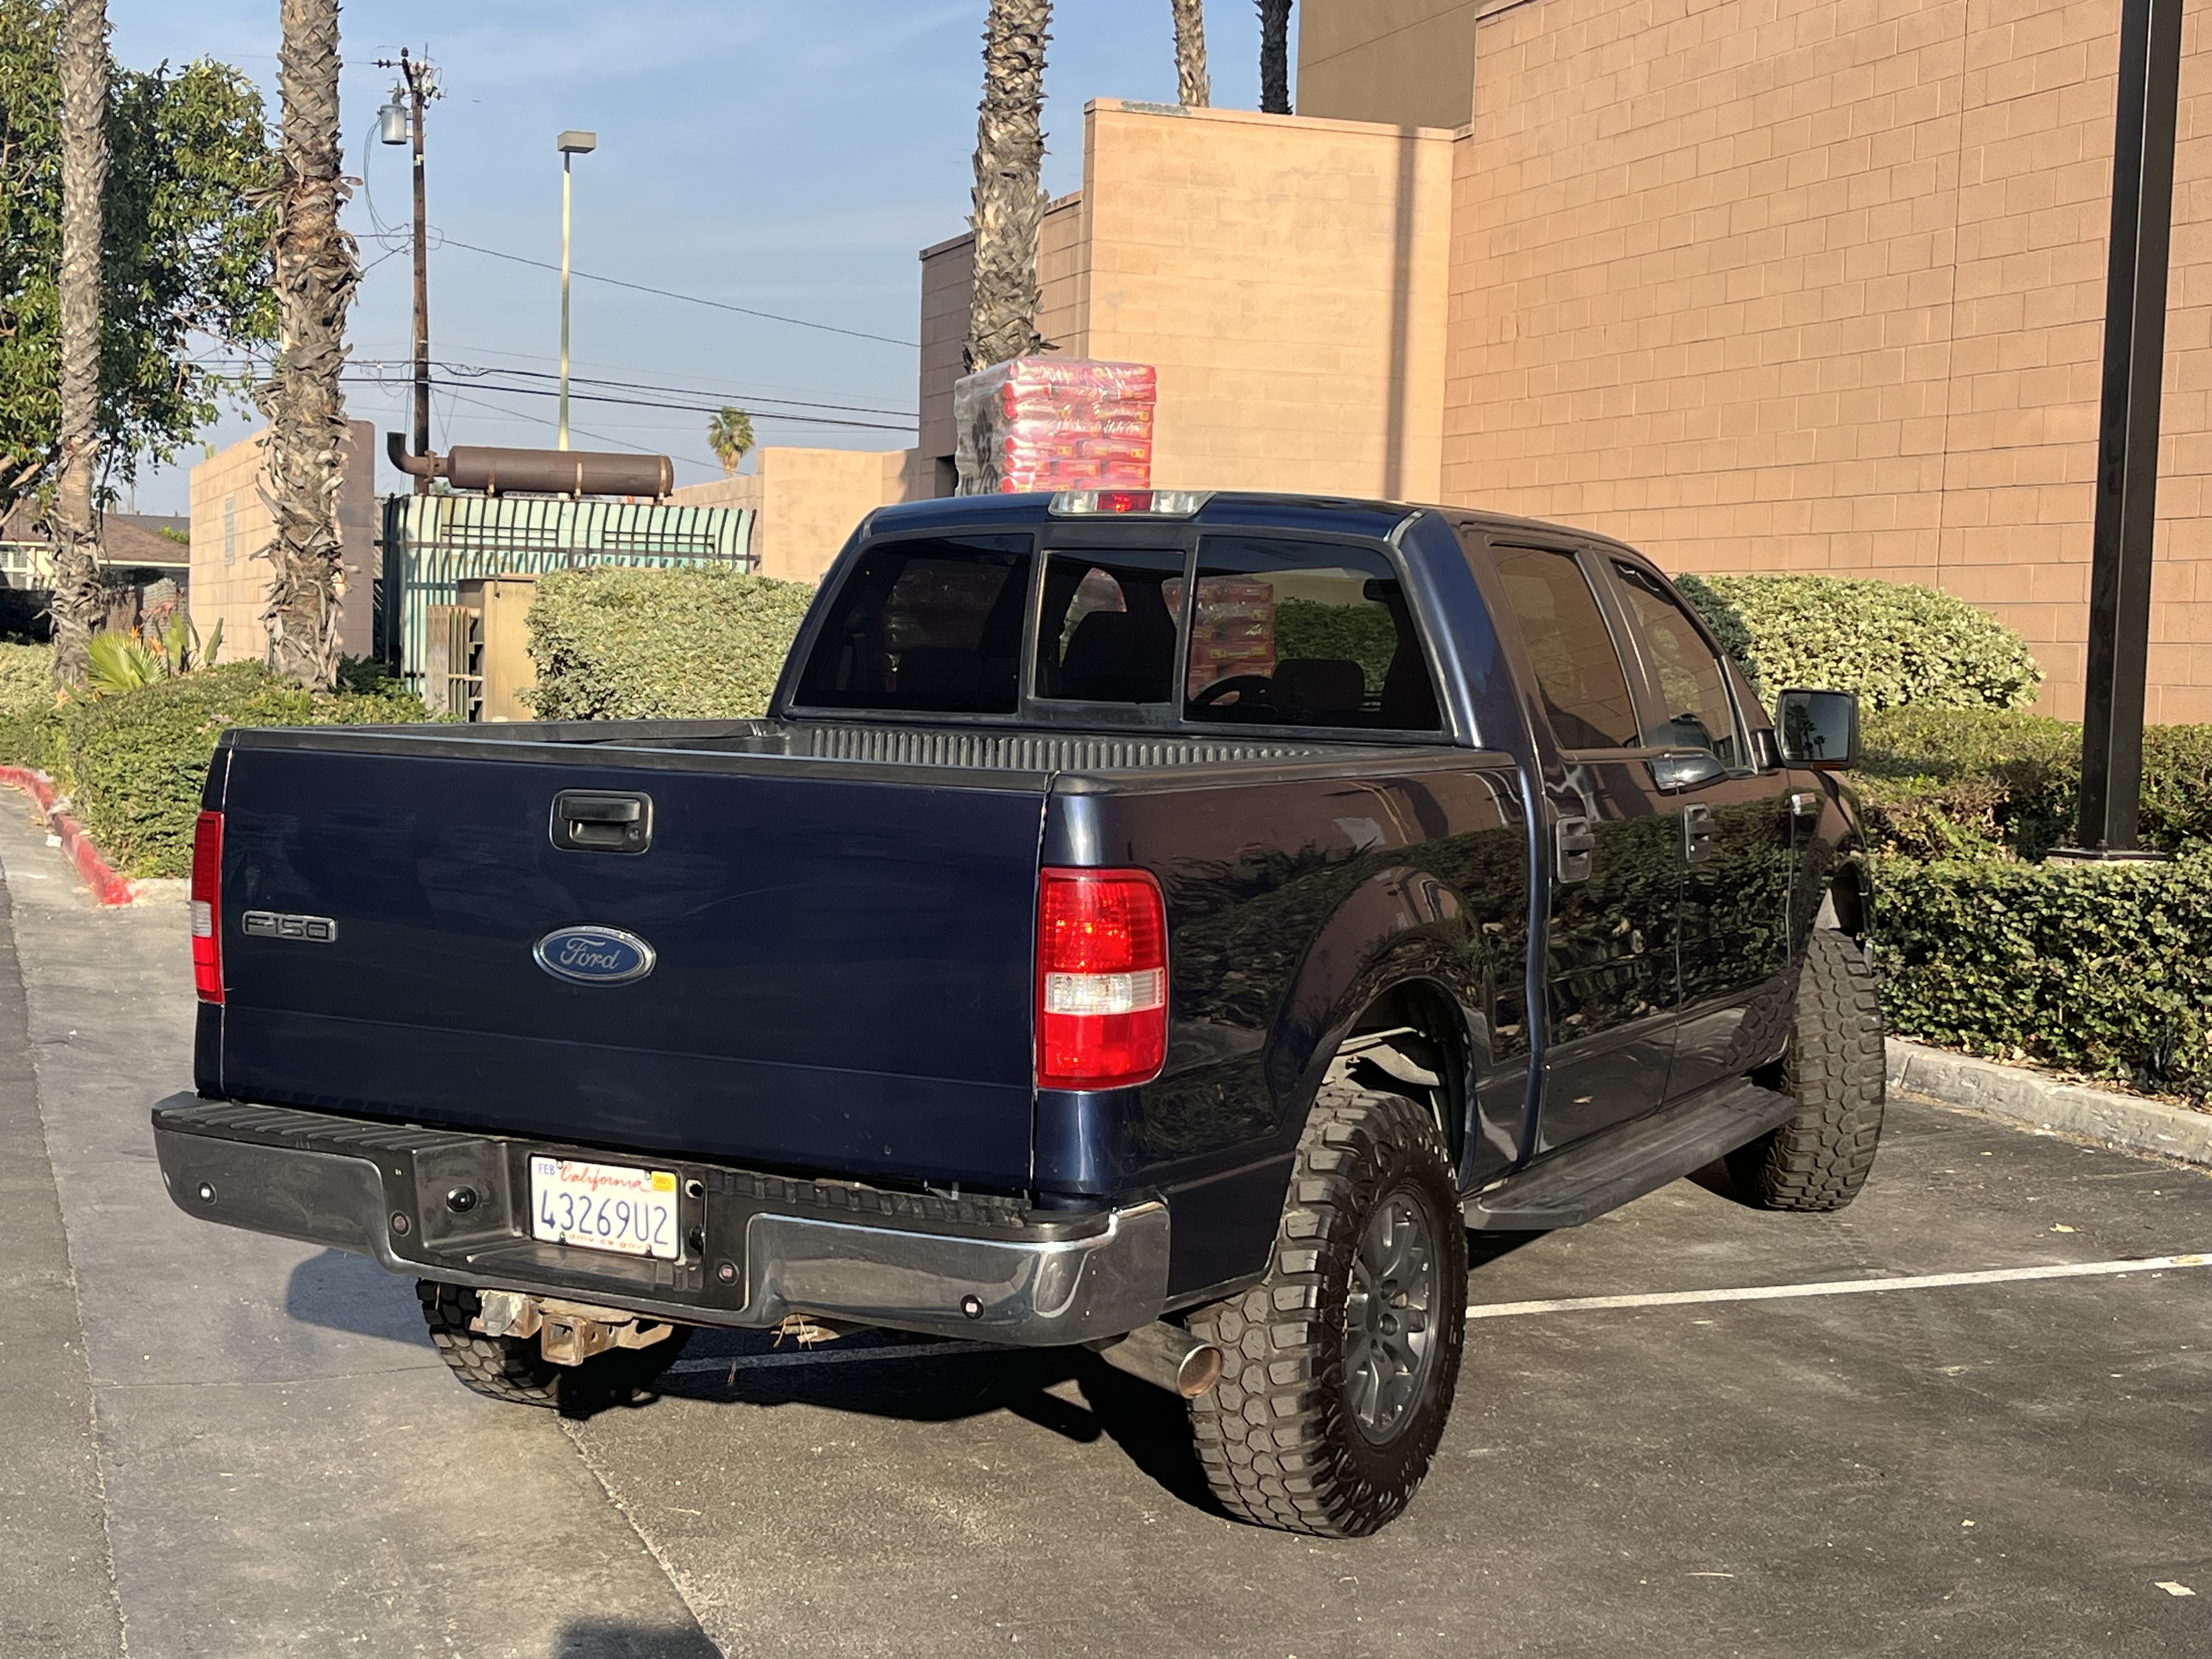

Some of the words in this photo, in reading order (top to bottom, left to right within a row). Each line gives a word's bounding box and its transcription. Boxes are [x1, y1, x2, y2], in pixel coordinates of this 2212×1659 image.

[560, 938, 621, 969] Ford
[538, 1163, 555, 1175] FEB
[560, 1162, 651, 1192] California
[541, 1189, 669, 1245] 43269U2
